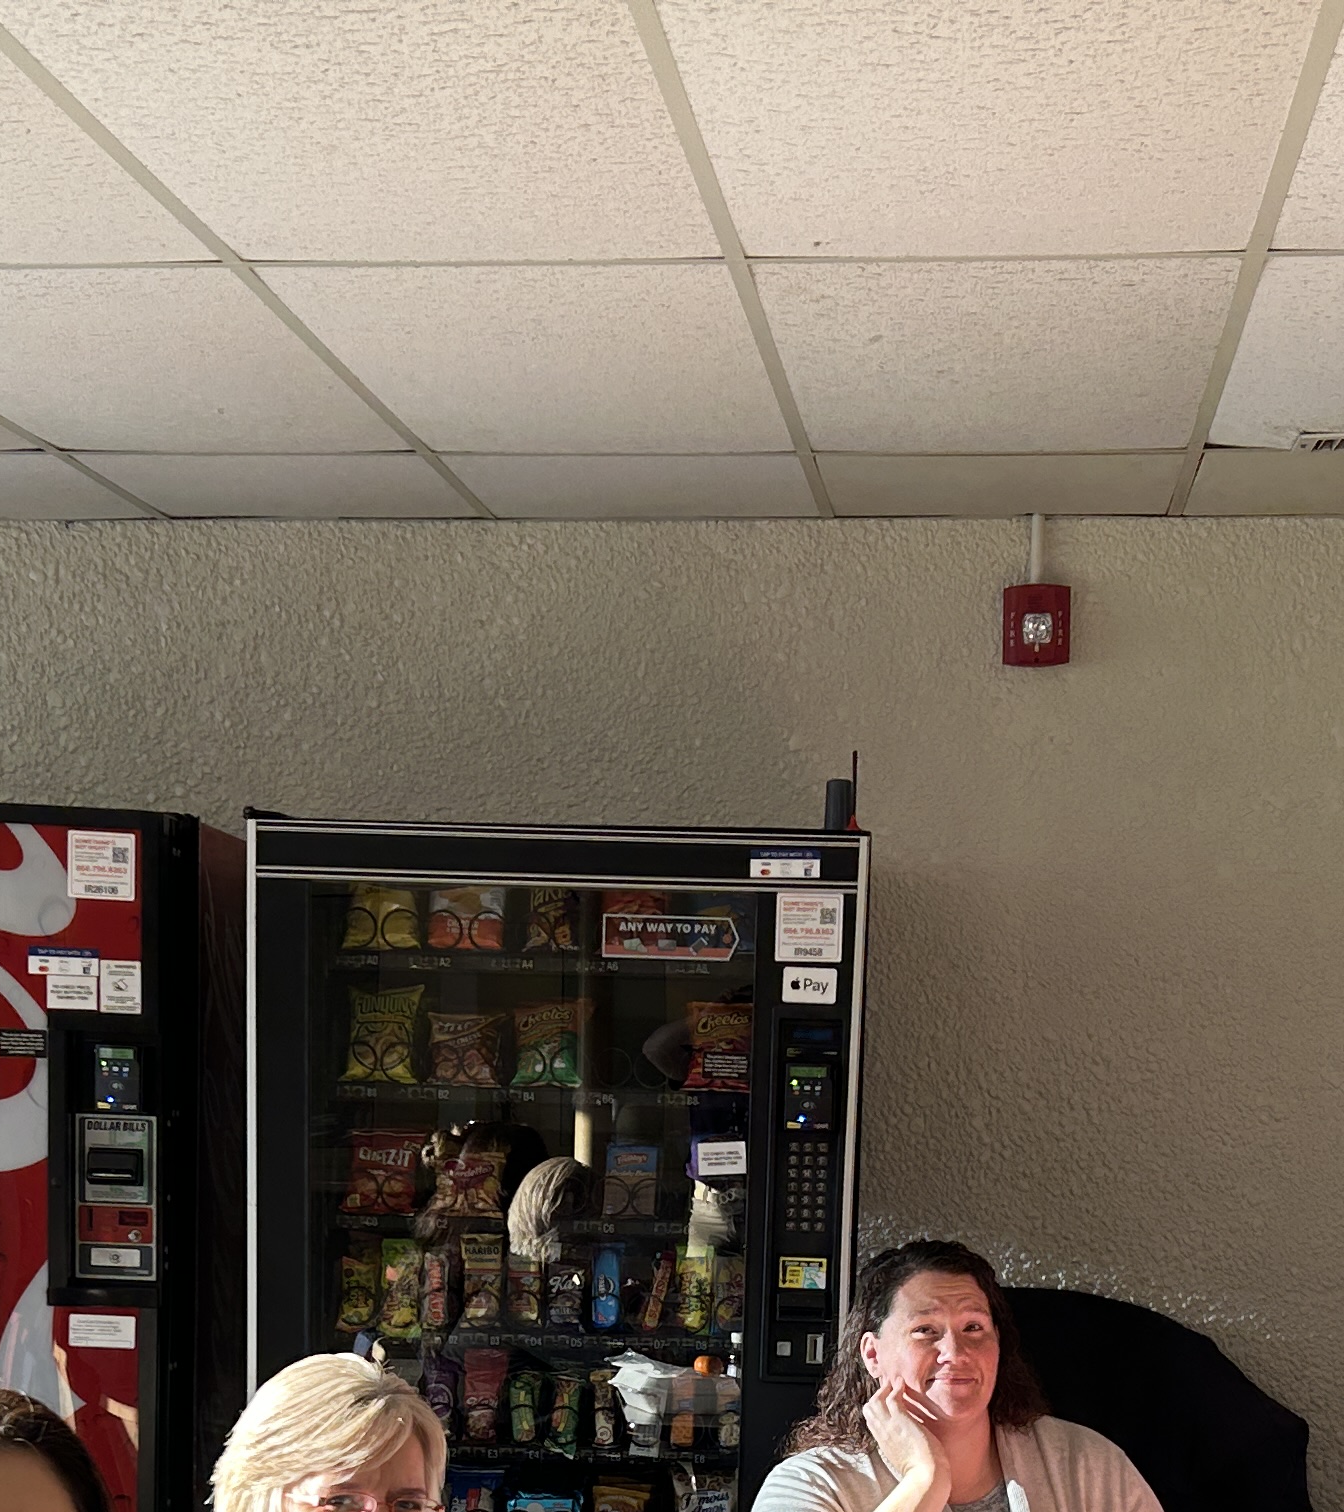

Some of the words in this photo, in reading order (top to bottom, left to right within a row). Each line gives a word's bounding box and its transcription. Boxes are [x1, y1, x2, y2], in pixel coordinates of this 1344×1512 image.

[1009, 611, 1017, 647] FIRE
[619, 922, 644, 933] ANY
[646, 922, 674, 934] WAY
[676, 923, 691, 934] TO
[694, 923, 717, 935] PAY
[803, 978, 829, 995] Pay
[519, 1006, 574, 1033] Cheetos
[697, 1013, 752, 1034] Cheetos
[87, 1120, 121, 1131] DOLLAR
[123, 1121, 147, 1132] BILLS
[464, 1246, 500, 1255] HARIBO
